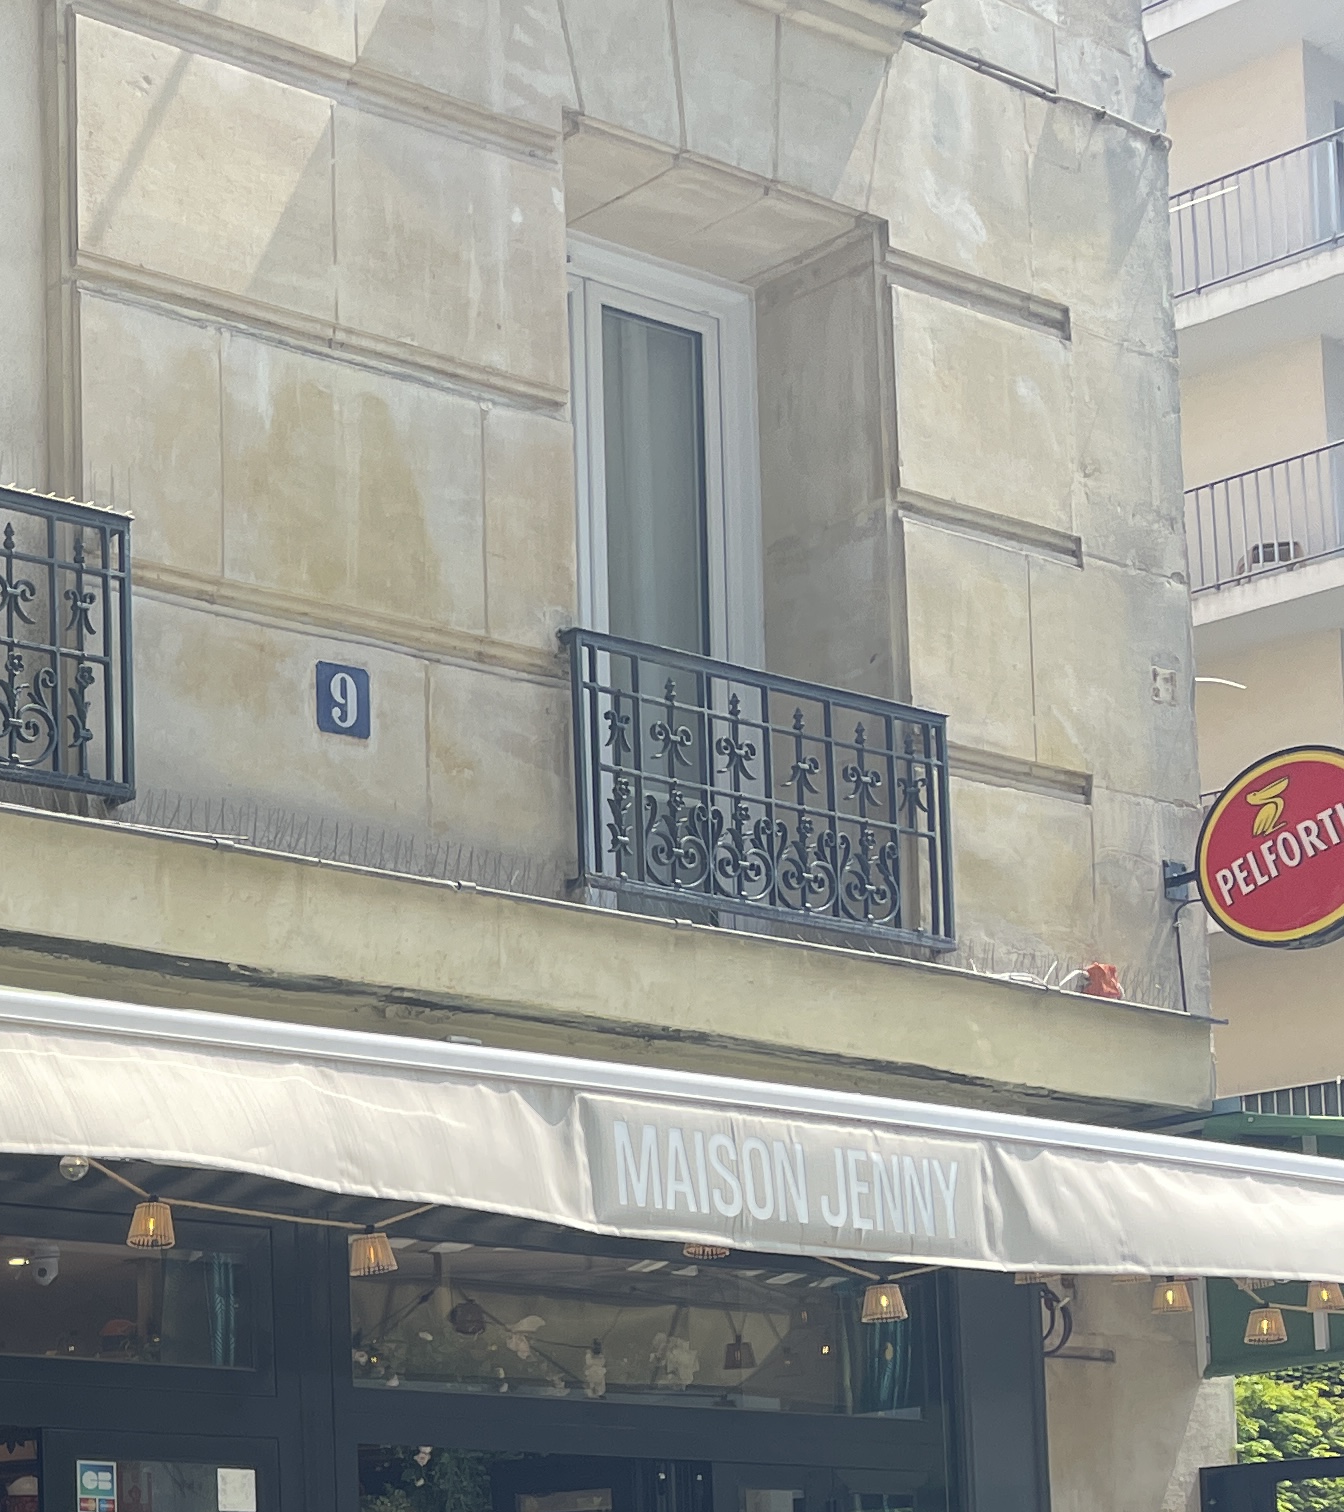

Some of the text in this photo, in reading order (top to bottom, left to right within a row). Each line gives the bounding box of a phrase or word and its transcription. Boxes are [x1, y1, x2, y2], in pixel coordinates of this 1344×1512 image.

[330, 672, 358, 729] 9
[613, 1120, 959, 1239] MAISON JENNY
